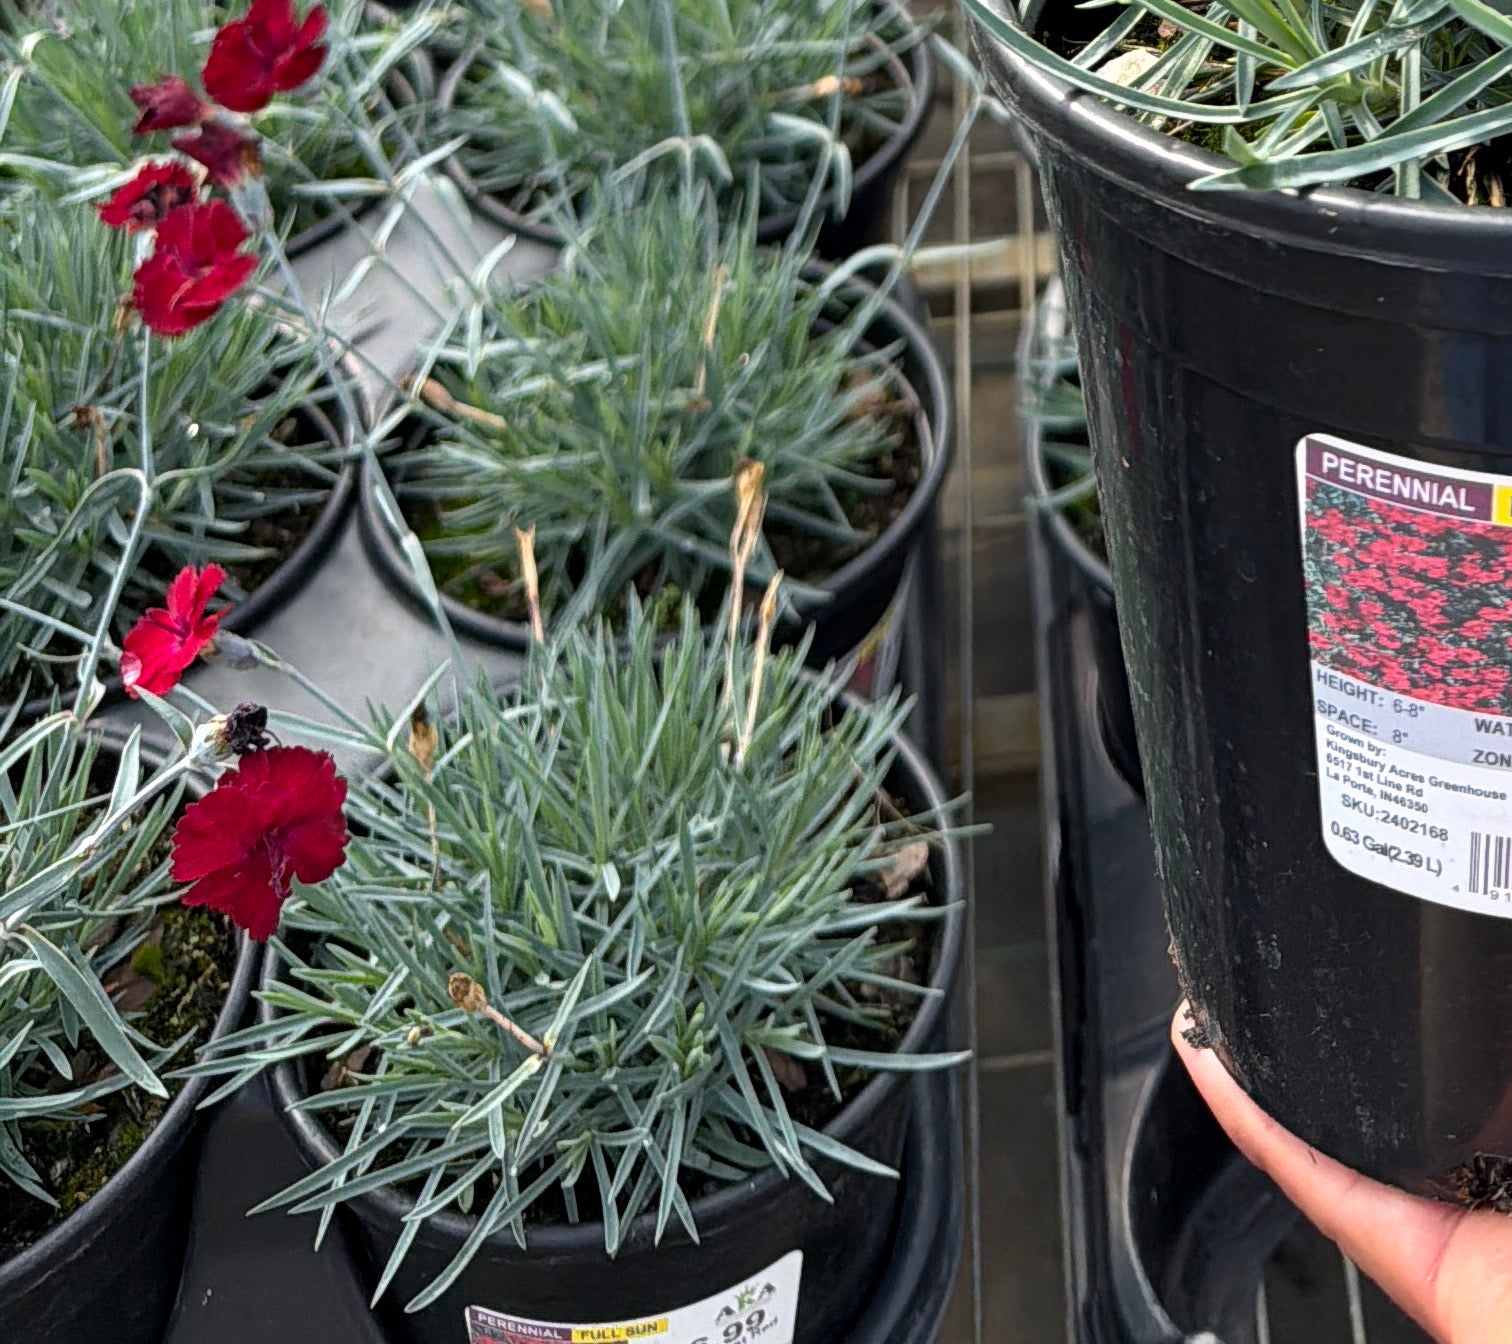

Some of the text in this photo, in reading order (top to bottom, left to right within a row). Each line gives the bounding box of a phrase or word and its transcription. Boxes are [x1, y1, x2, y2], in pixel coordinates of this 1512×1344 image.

[1322, 451, 1476, 512] PERENNIAL
[1316, 669, 1384, 707] HEIGHT:
[1317, 699, 1378, 736] SPACE:
[1326, 724, 1387, 757] Grown by:
[1326, 738, 1507, 801] Kingsbury Acres Greenhouse
[1326, 767, 1340, 781] La
[1326, 753, 1424, 798] 6517 1st Line Rd
[1330, 820, 1360, 846] 0.63
[1341, 793, 1449, 841] SKU:2402168
[478, 1312, 563, 1339] PERENNIAL
[580, 1321, 658, 1340] FULL SUN
